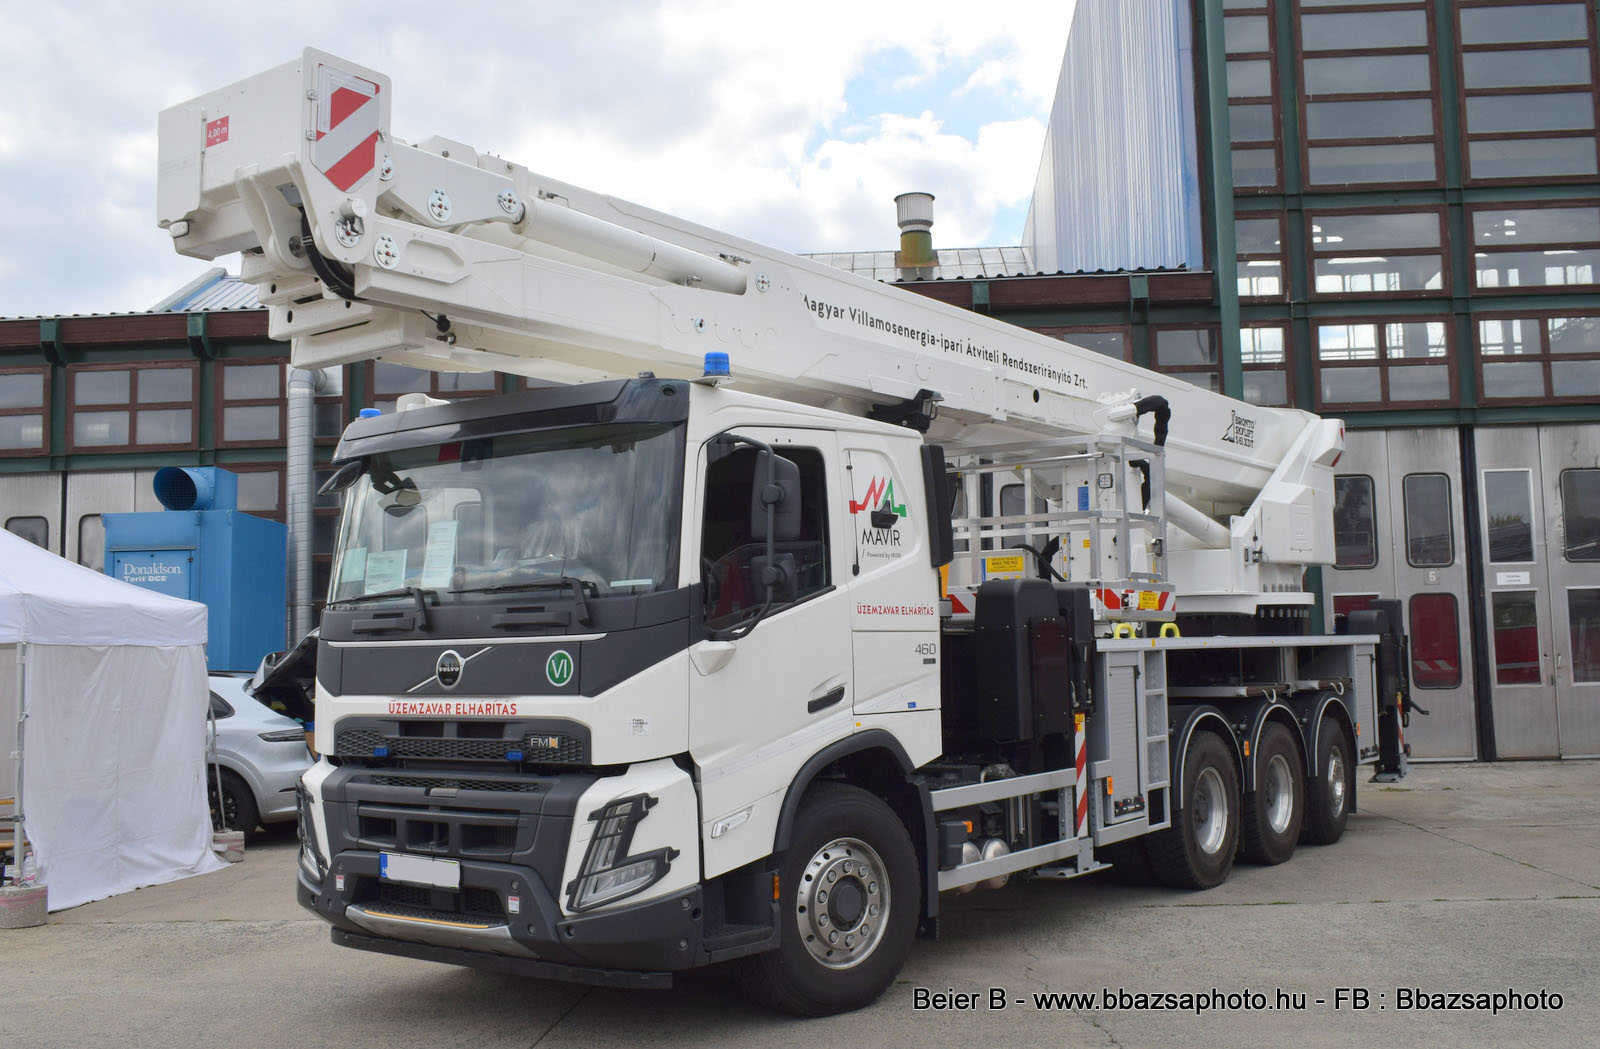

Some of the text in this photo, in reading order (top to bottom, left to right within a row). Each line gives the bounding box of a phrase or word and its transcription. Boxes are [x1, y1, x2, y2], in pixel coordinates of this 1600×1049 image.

[848, 306, 963, 353] Villamosenergia-ipari
[966, 337, 1000, 364] Átviteli
[1002, 352, 1072, 385] Rendszerirányító
[1074, 373, 1089, 390] Zrt.
[861, 528, 901, 547] MAVIR
[1428, 570, 1437, 582] 5
[856, 601, 935, 616] ÜZEMZAVAR ELHÁRÍTÁS
[914, 643, 937, 655] 460
[551, 658, 567, 679] VI
[388, 699, 518, 715] ÜZEMZAVAR ELHÁRÍTÁS
